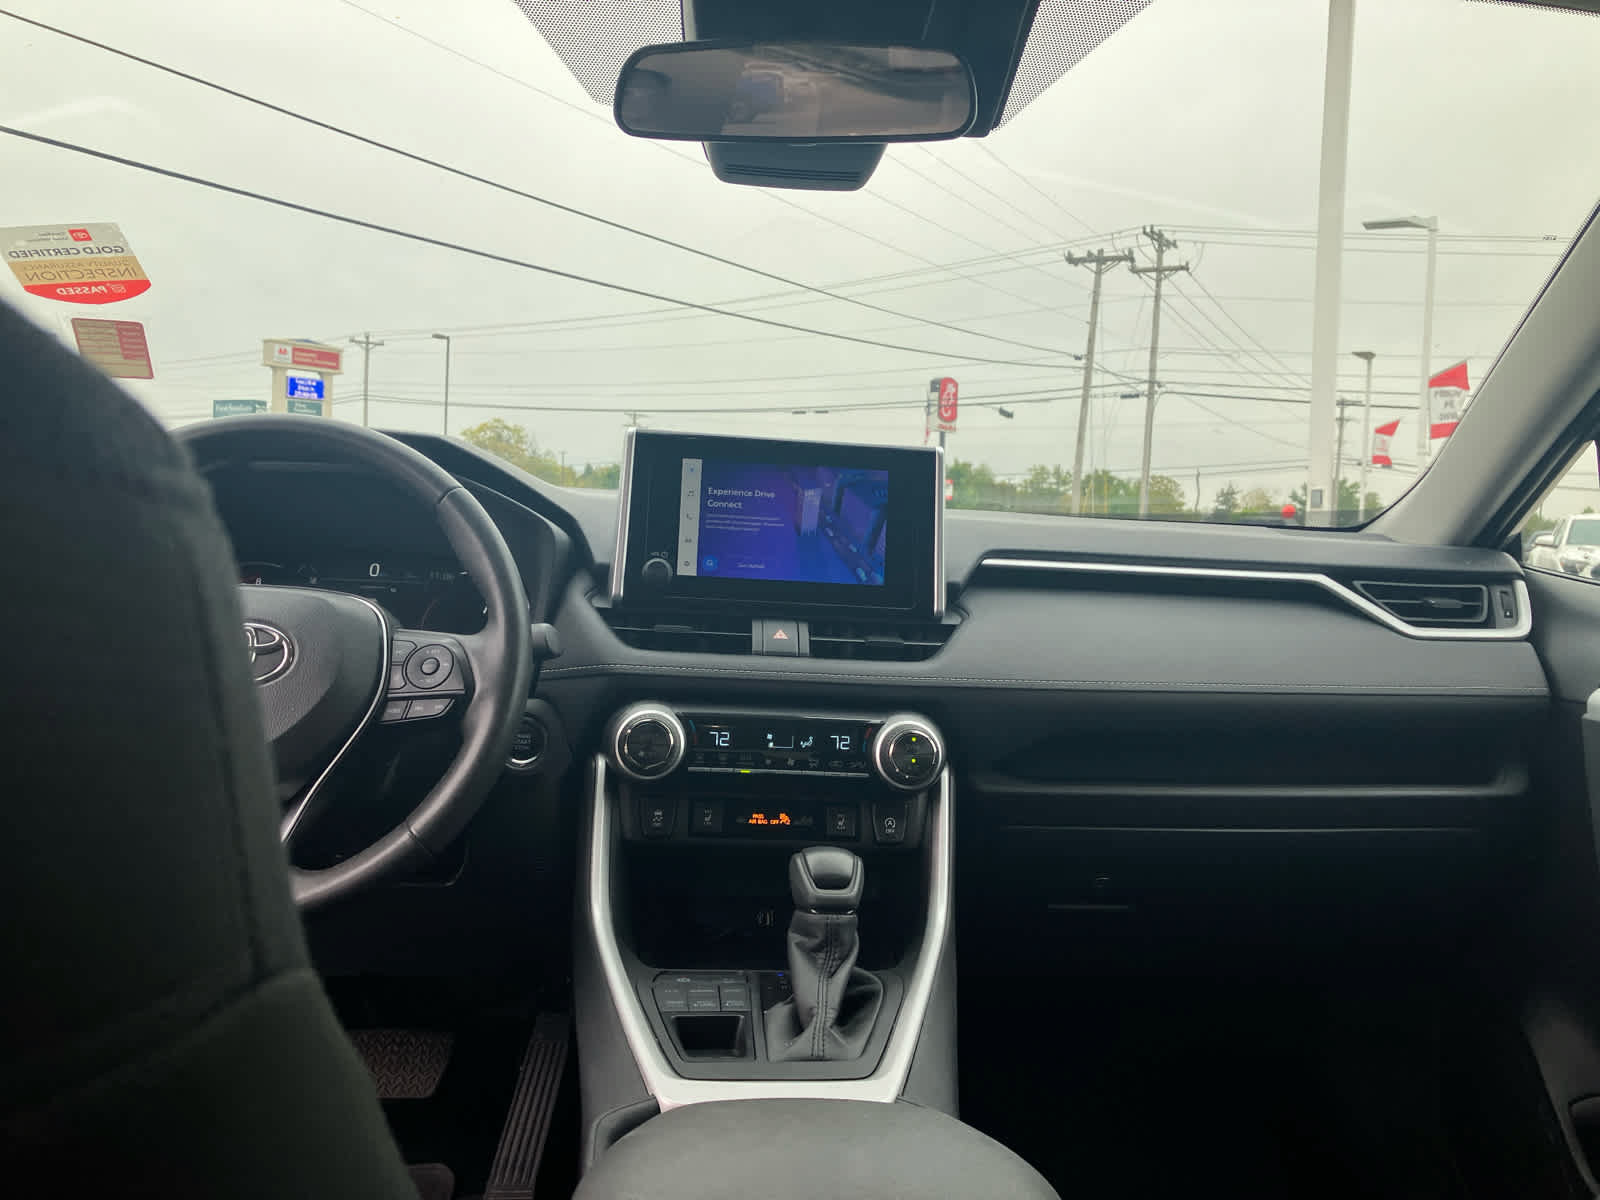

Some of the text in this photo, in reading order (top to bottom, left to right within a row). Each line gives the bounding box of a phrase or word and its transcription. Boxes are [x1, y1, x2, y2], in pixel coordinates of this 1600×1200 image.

[708, 487, 776, 499] Experience Drive
[707, 499, 743, 509] Connect
[709, 731, 730, 747] 72
[830, 735, 851, 750] 72
